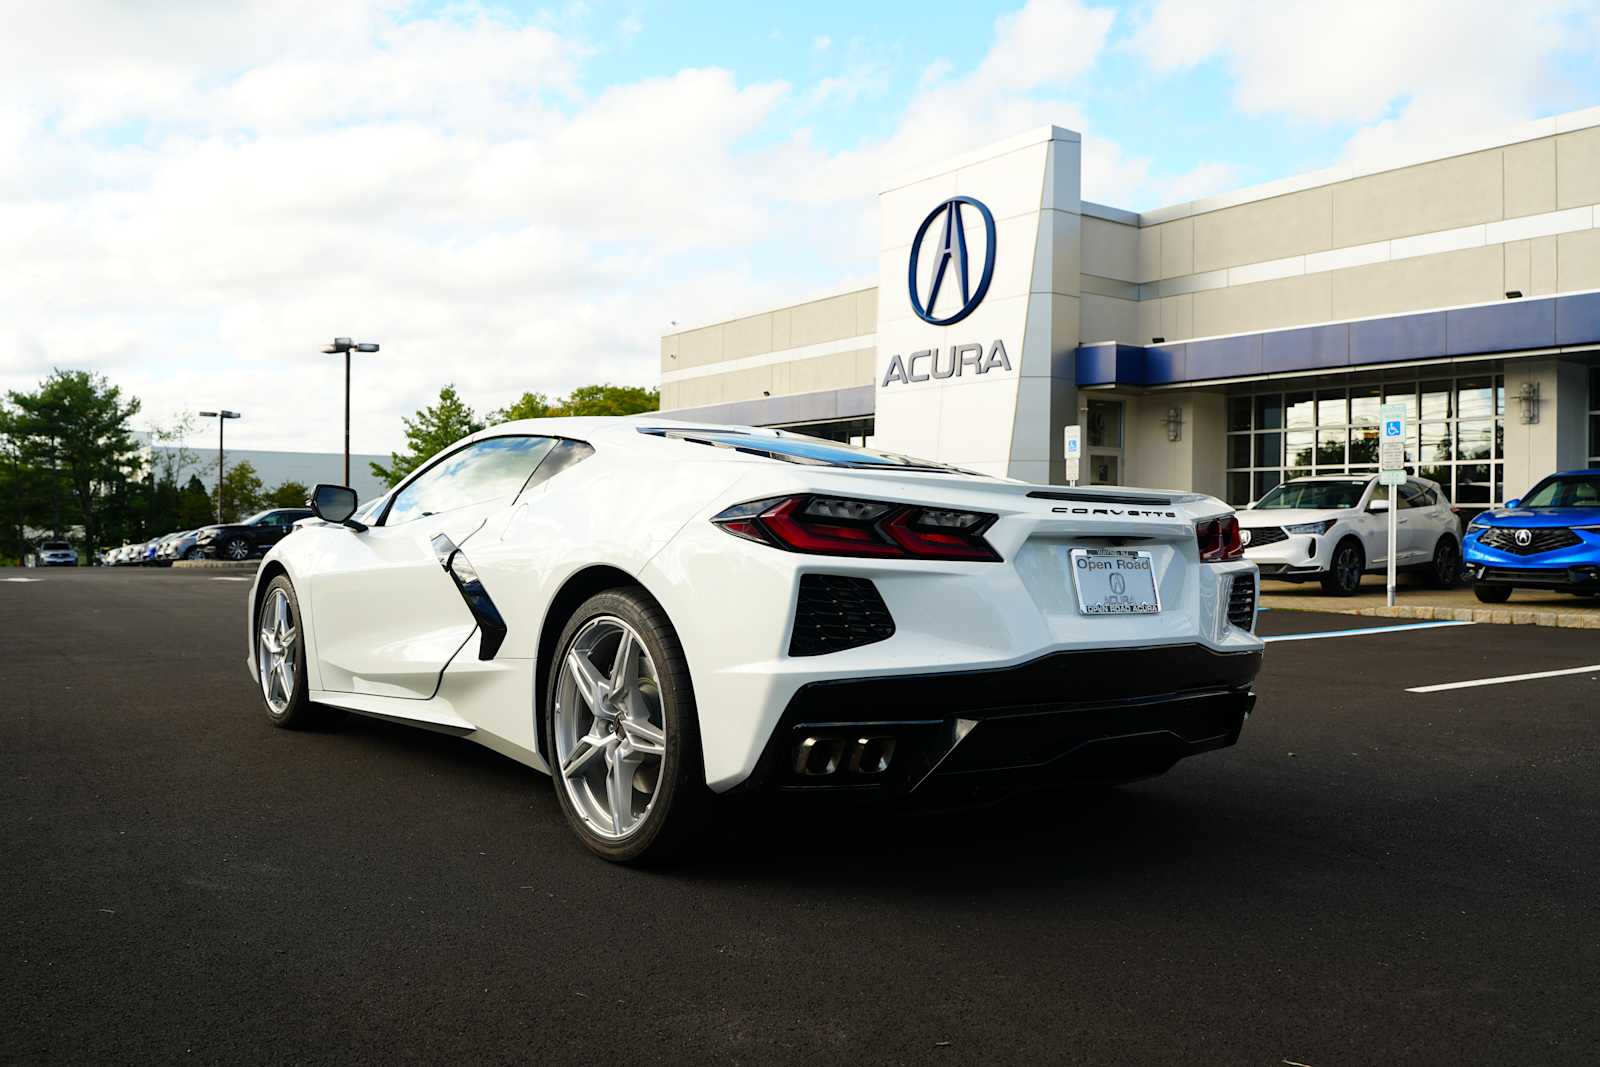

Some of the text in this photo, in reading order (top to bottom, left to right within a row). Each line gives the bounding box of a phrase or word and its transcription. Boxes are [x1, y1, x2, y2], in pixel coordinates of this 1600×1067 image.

[882, 339, 1012, 387] ACURA
[1051, 507, 1176, 518] CORVETTE
[1077, 558, 1150, 571] Open Road
[1087, 604, 1158, 613] OPEN ROAD ACURA
